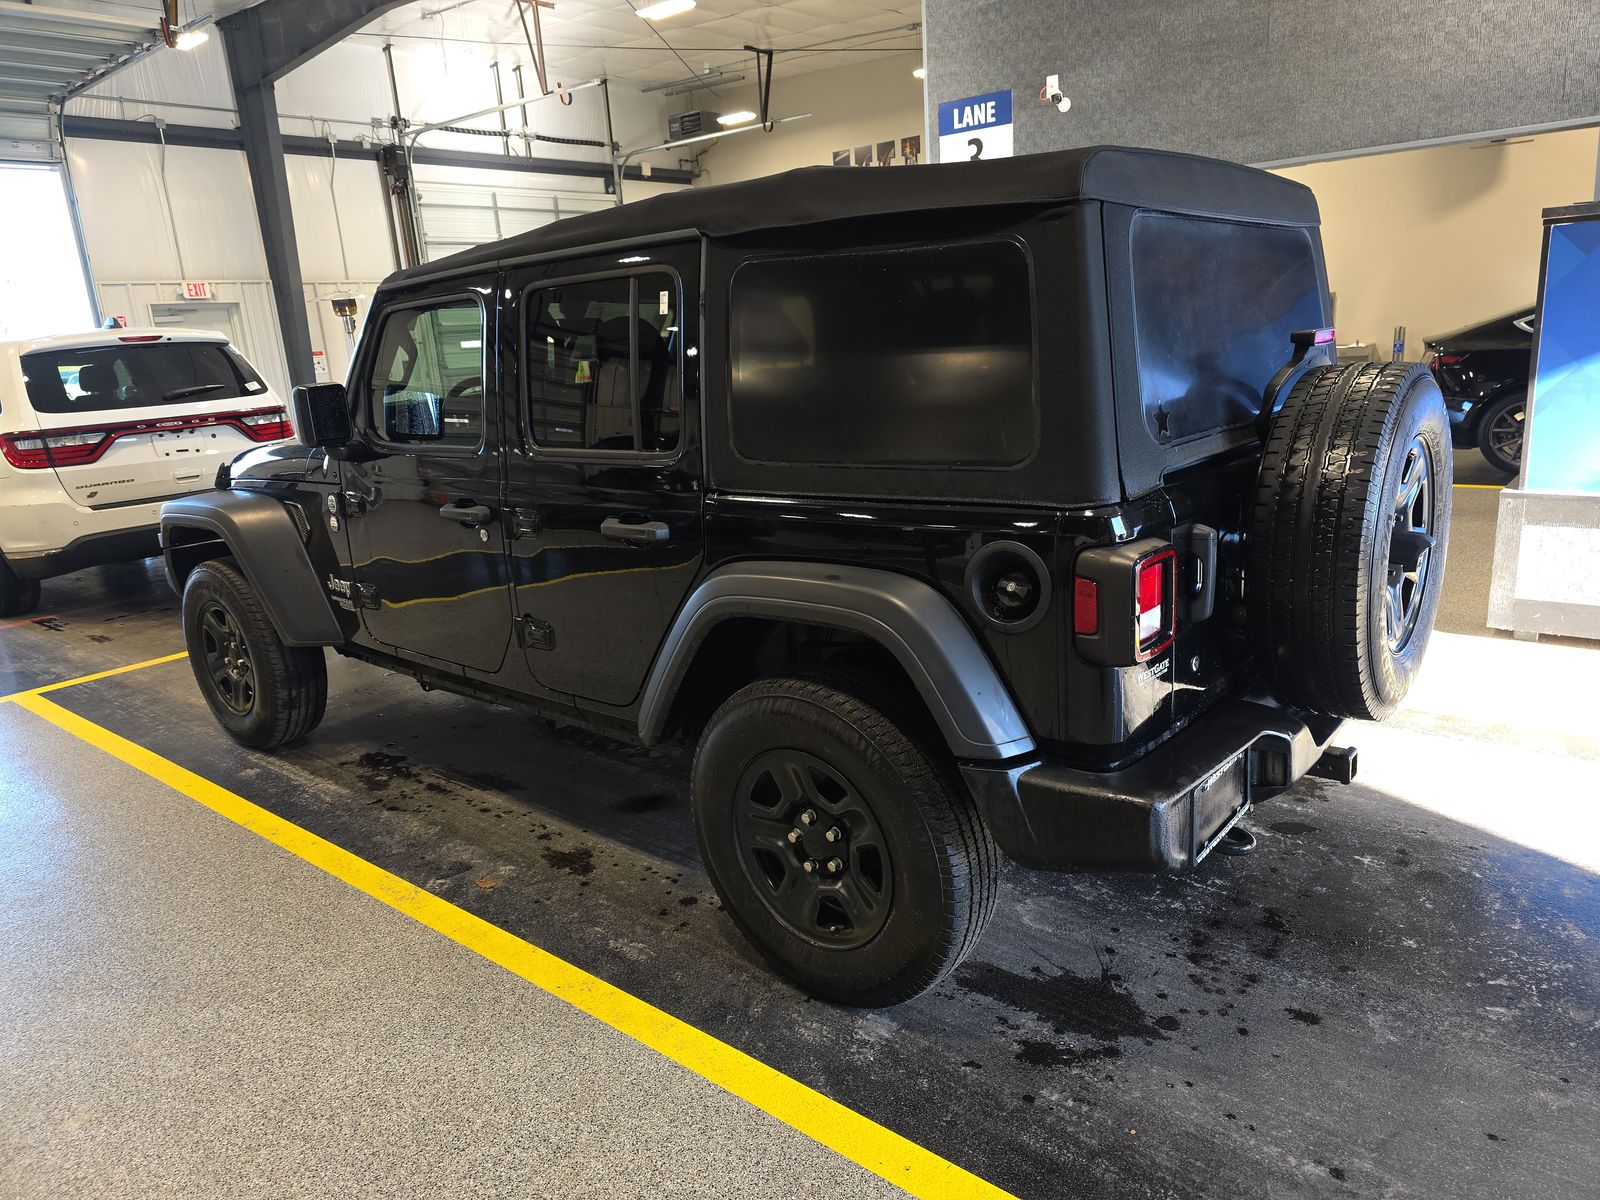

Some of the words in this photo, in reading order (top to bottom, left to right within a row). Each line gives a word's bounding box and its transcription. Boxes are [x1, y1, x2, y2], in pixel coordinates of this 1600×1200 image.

[953, 101, 996, 129] LANE
[187, 283, 206, 296] EXIT
[75, 479, 135, 489] DURANGO
[327, 574, 350, 598] Jeep
